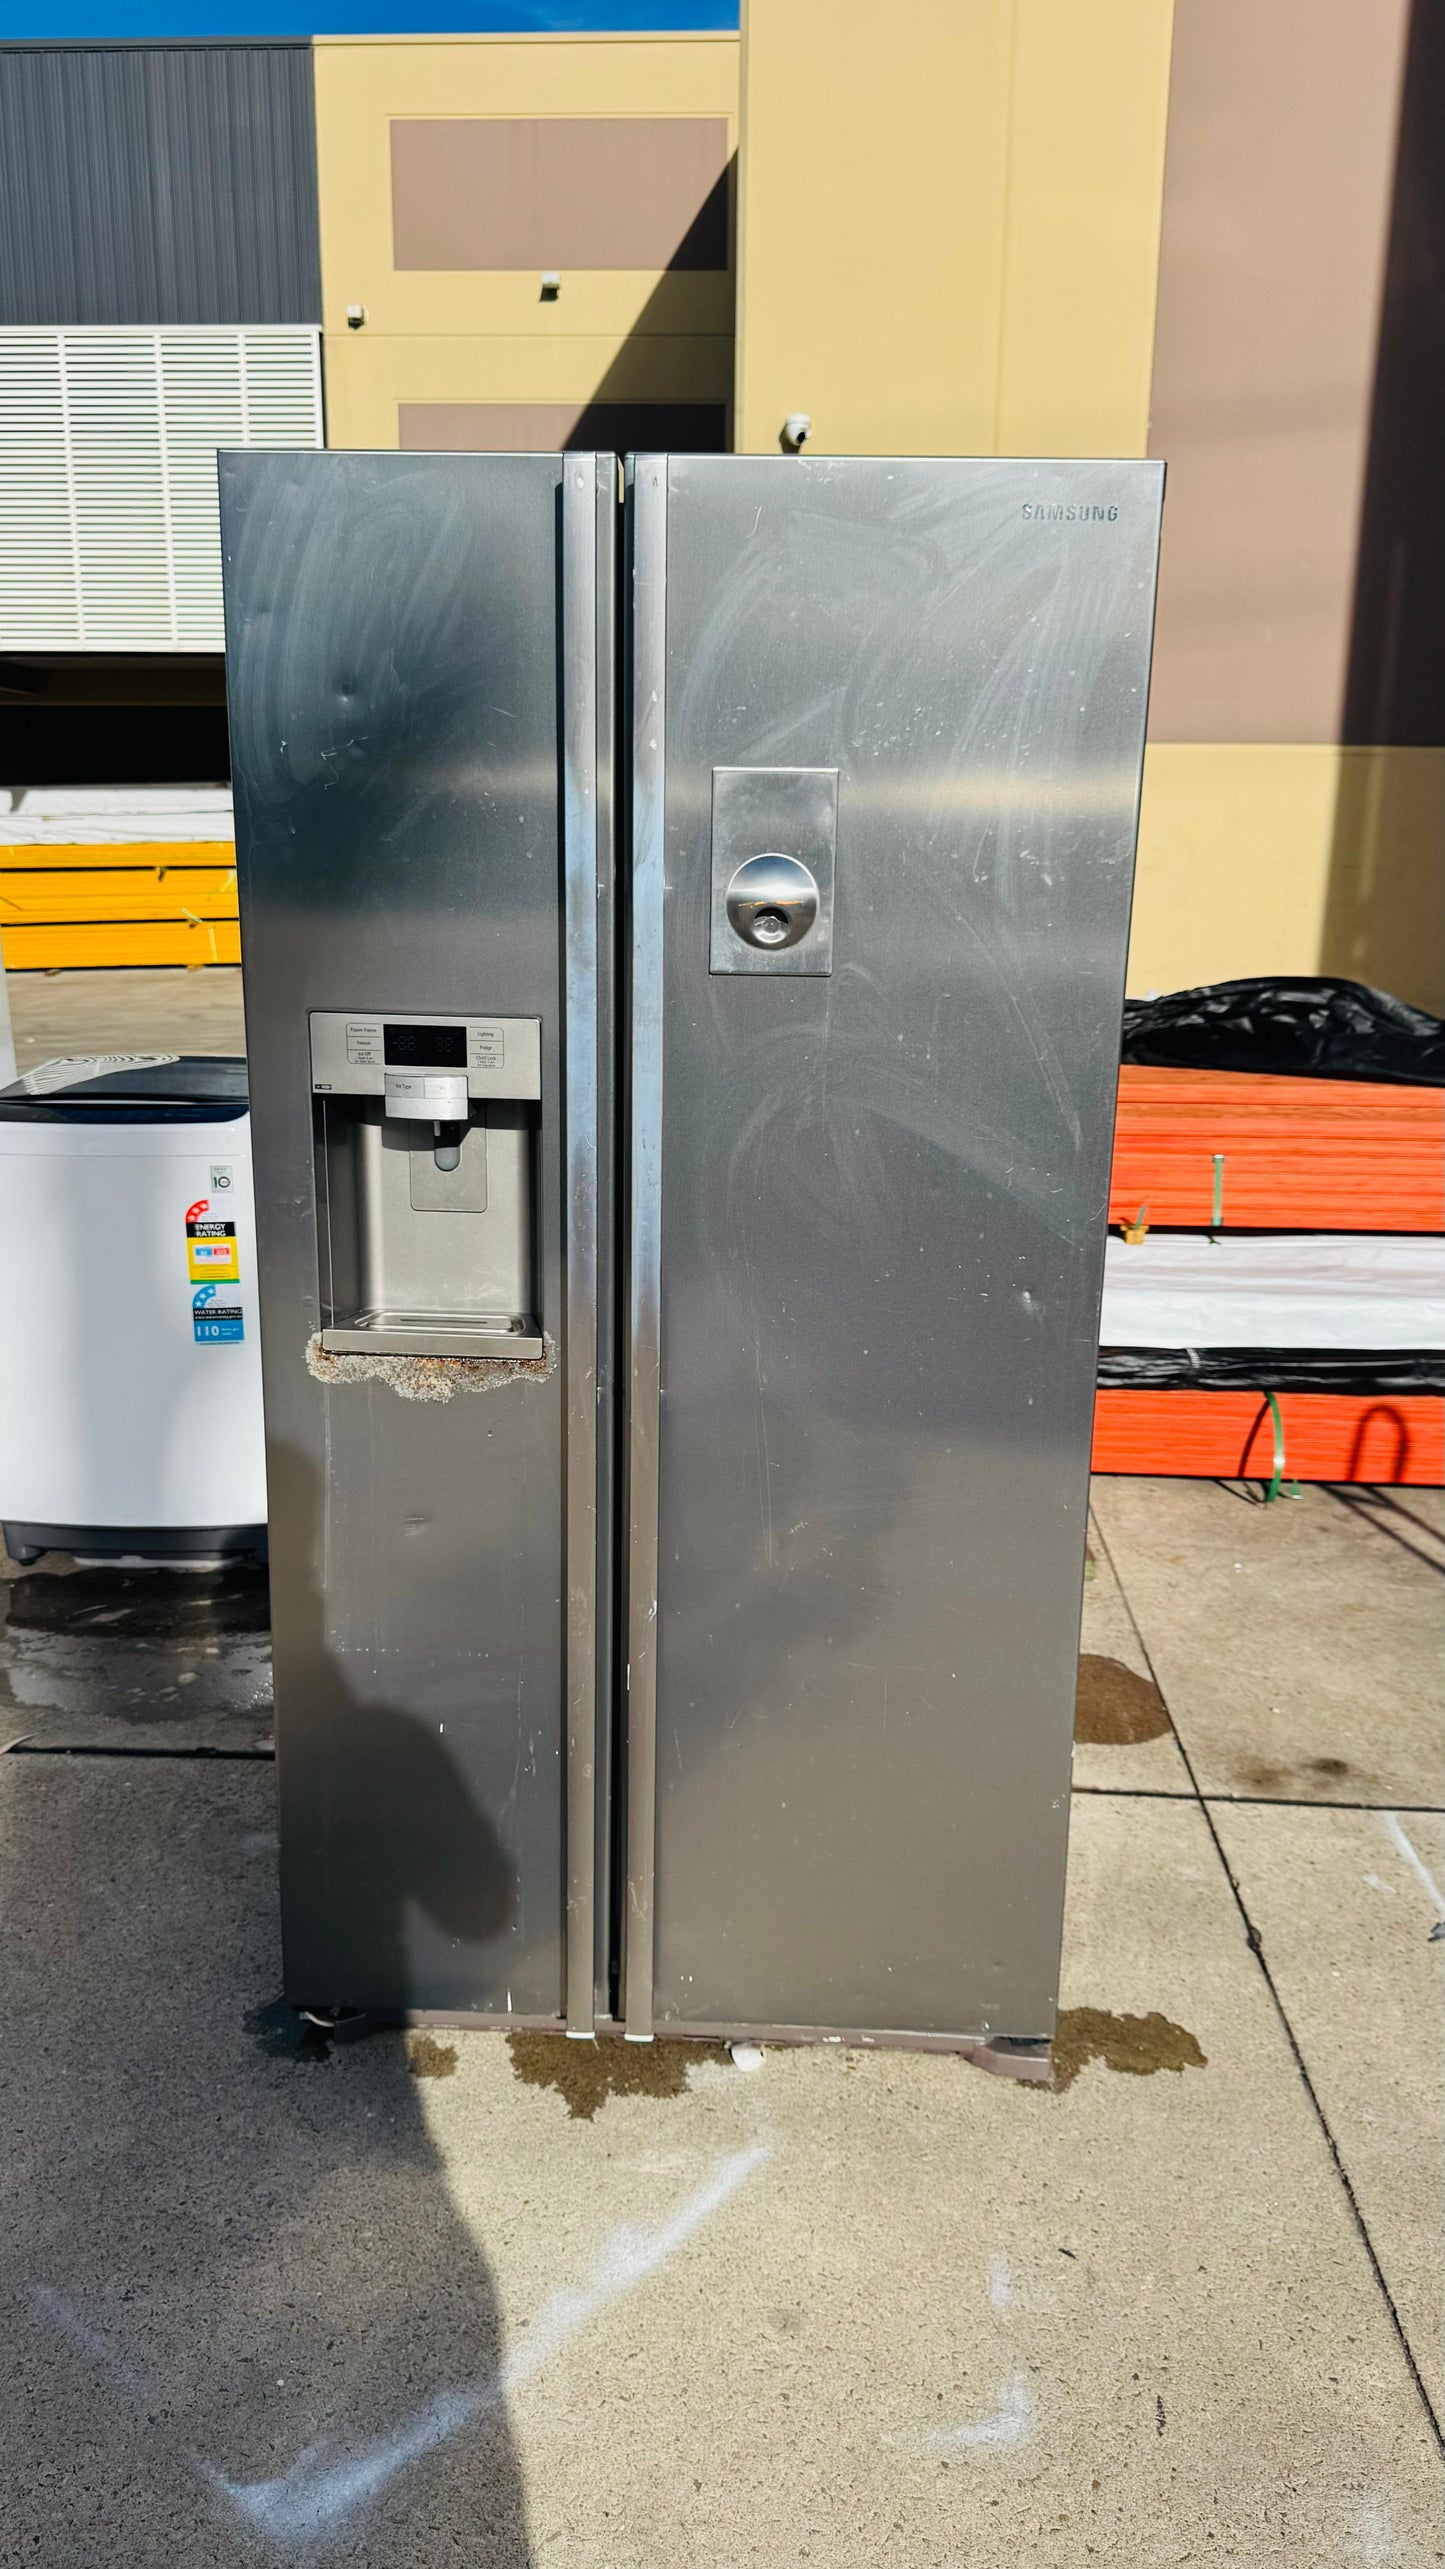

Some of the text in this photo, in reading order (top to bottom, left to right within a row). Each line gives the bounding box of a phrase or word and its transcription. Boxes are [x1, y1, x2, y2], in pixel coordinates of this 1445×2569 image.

[1022, 503, 1119, 521] SAMSUNG
[213, 1176, 231, 1189] 10
[197, 1325, 219, 1337] 110
